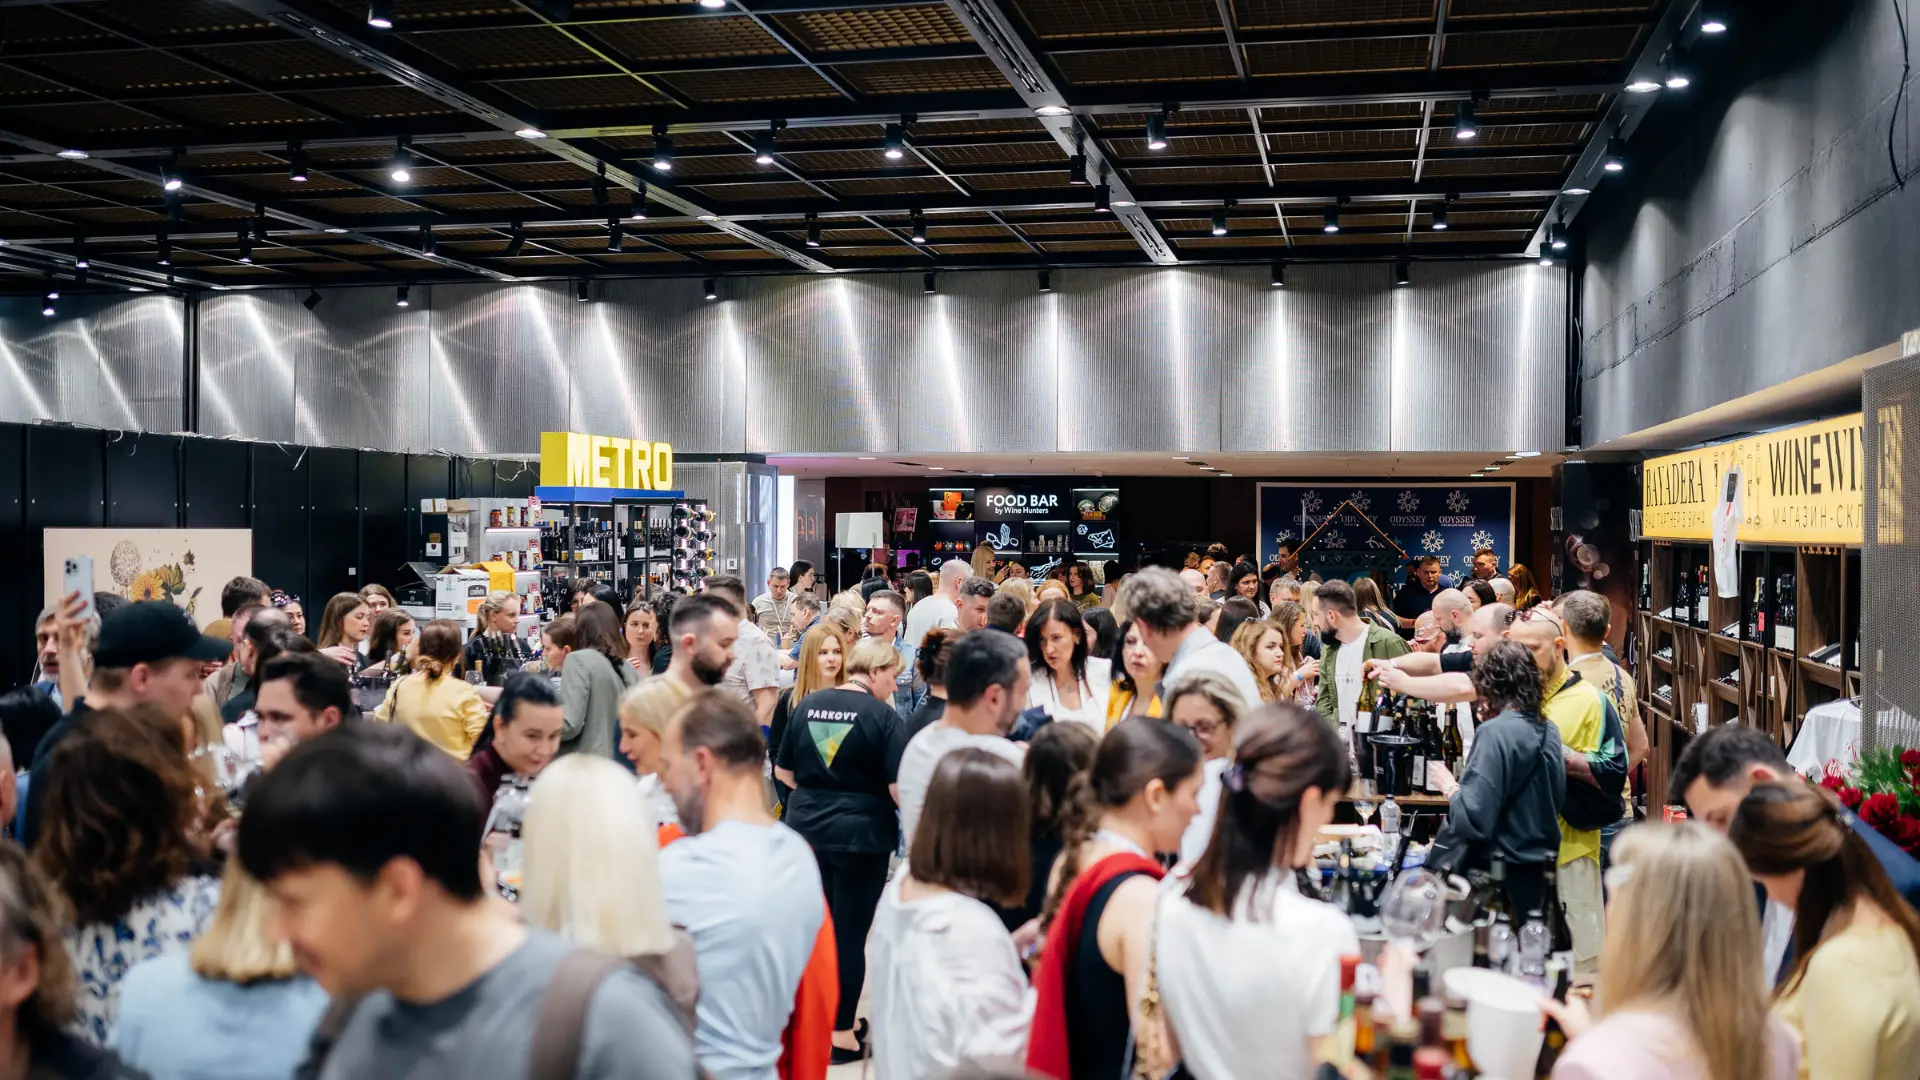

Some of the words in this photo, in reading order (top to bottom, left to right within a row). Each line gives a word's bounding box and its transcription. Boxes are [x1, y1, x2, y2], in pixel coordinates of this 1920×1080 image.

[567, 432, 673, 491] METRO
[1646, 457, 1706, 507] BAYADERA
[986, 494, 1027, 506] FOOD
[1030, 494, 1058, 506] BAR
[995, 506, 1004, 515] by
[1004, 506, 1022, 514] Wine
[1023, 506, 1049, 514] Hunters
[1389, 515, 1427, 524] ODYSSEY
[1438, 515, 1476, 524] ODYSSEY
[807, 709, 857, 721] PARKOVY
